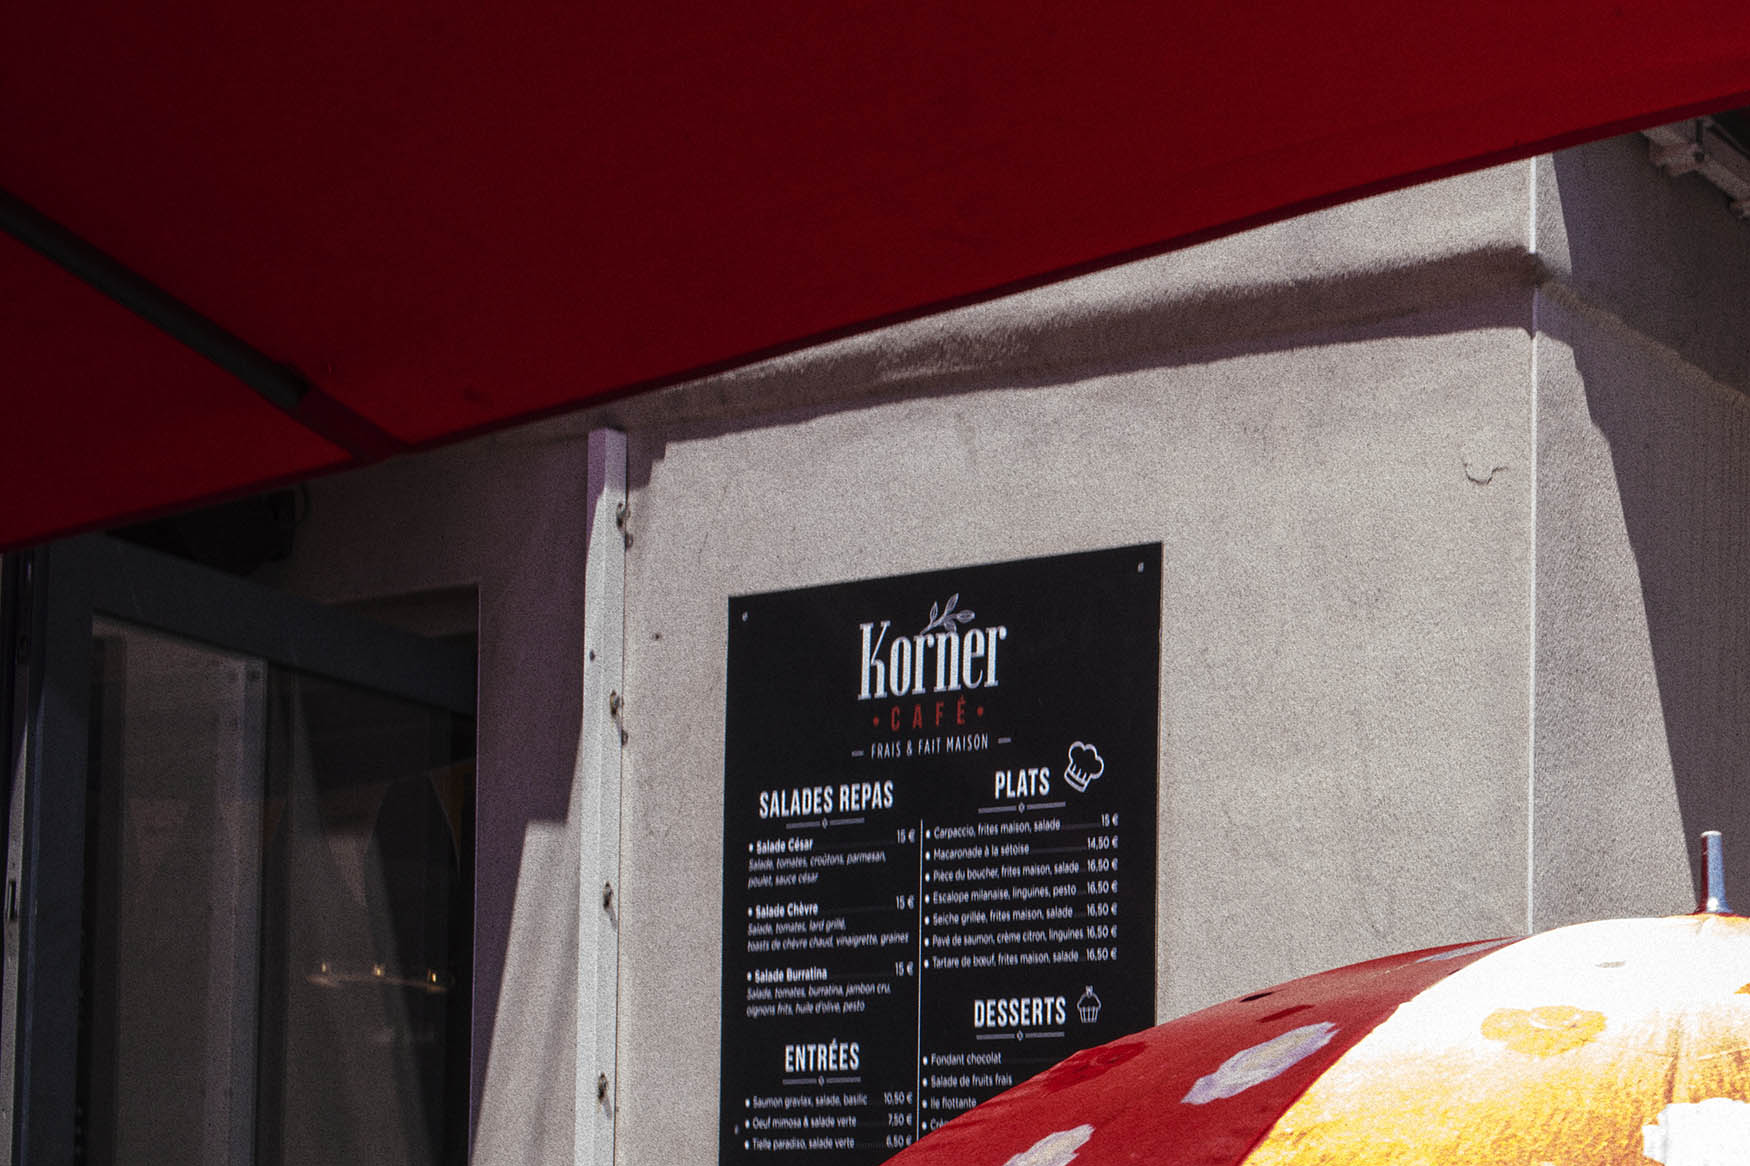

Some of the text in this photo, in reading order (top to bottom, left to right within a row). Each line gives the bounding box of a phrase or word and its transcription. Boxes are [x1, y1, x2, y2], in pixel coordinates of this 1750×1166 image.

[858, 620, 1007, 700] Korner
[891, 696, 965, 730] CAFÉ
[871, 733, 988, 758] FRAIS & FAIT MAISON
[994, 767, 1050, 799] PLATS
[759, 780, 893, 818] SALADES REPAS
[1101, 813, 1110, 826] 15
[1112, 813, 1118, 826] €
[897, 829, 906, 843] 15
[908, 828, 915, 842] €
[1111, 835, 1118, 848] €
[1111, 858, 1118, 870] €
[1110, 880, 1117, 892] €
[896, 895, 905, 909] 15
[907, 895, 914, 908] €
[1110, 902, 1117, 915] €
[1110, 924, 1117, 937] €
[1110, 947, 1117, 960] €
[895, 961, 904, 976] 15
[906, 961, 913, 975] €
[974, 996, 1066, 1027] DESSERTS
[784, 1038, 859, 1072] ENTRÉES
[906, 1091, 912, 1104] €
[803, 1116, 808, 1127] &
[906, 1113, 912, 1125] €
